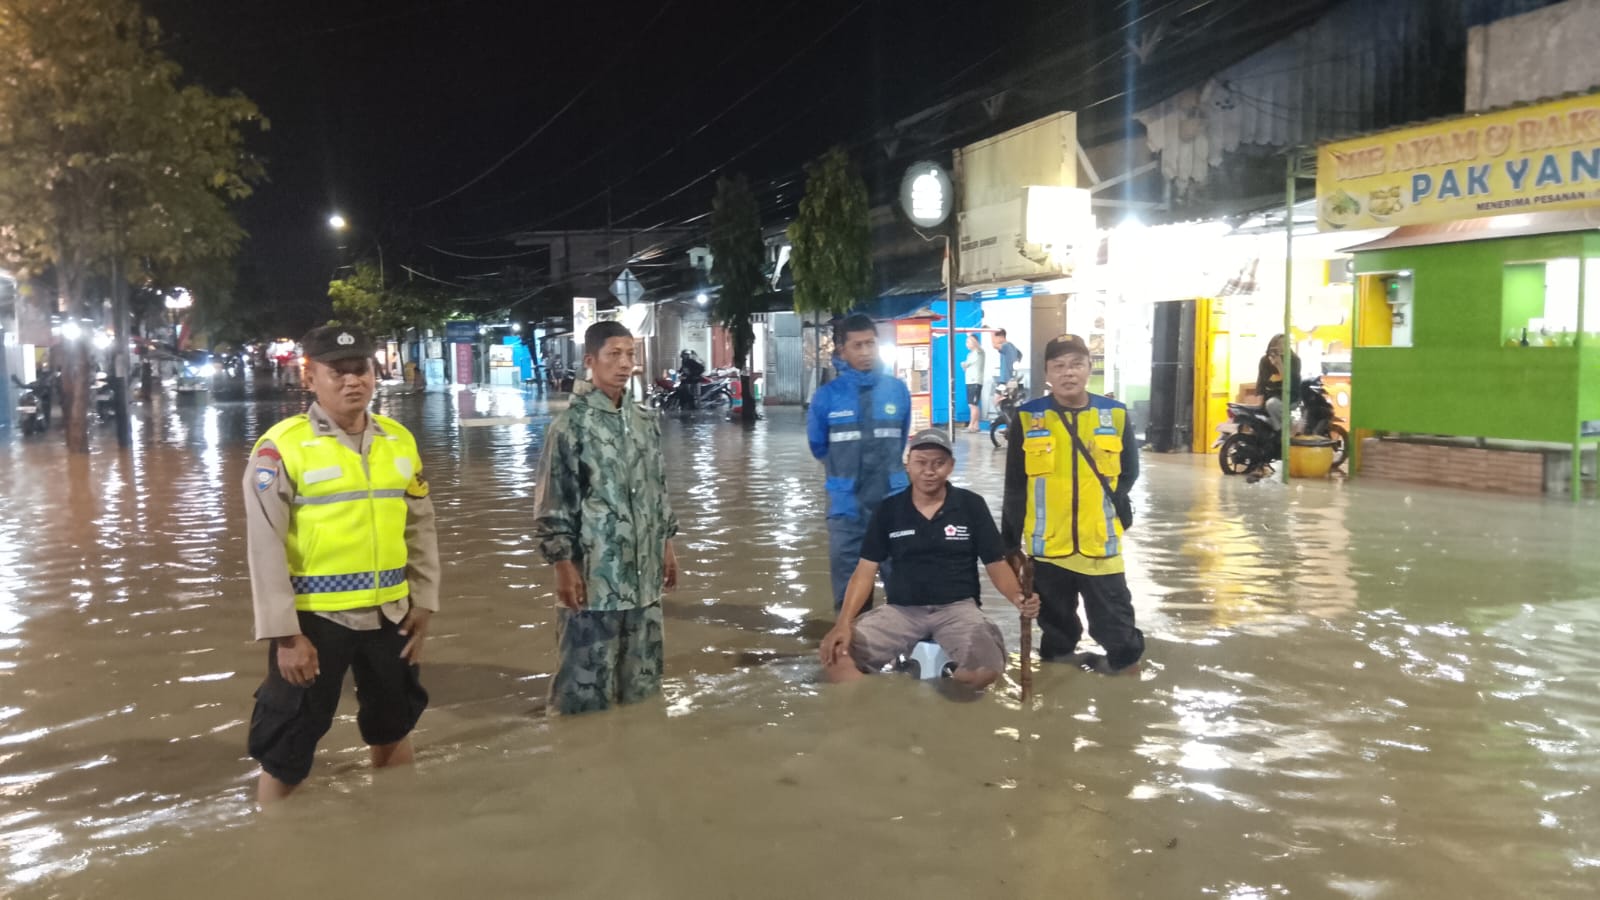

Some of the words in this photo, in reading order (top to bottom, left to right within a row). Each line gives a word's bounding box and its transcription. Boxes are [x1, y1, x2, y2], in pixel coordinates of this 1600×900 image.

[1393, 130, 1477, 172] AYAM
[1411, 164, 1490, 203] PAK
[1505, 147, 1600, 189] YAN
[1477, 198, 1530, 210] MENERIMA
[1534, 192, 1585, 204] PESANAN
